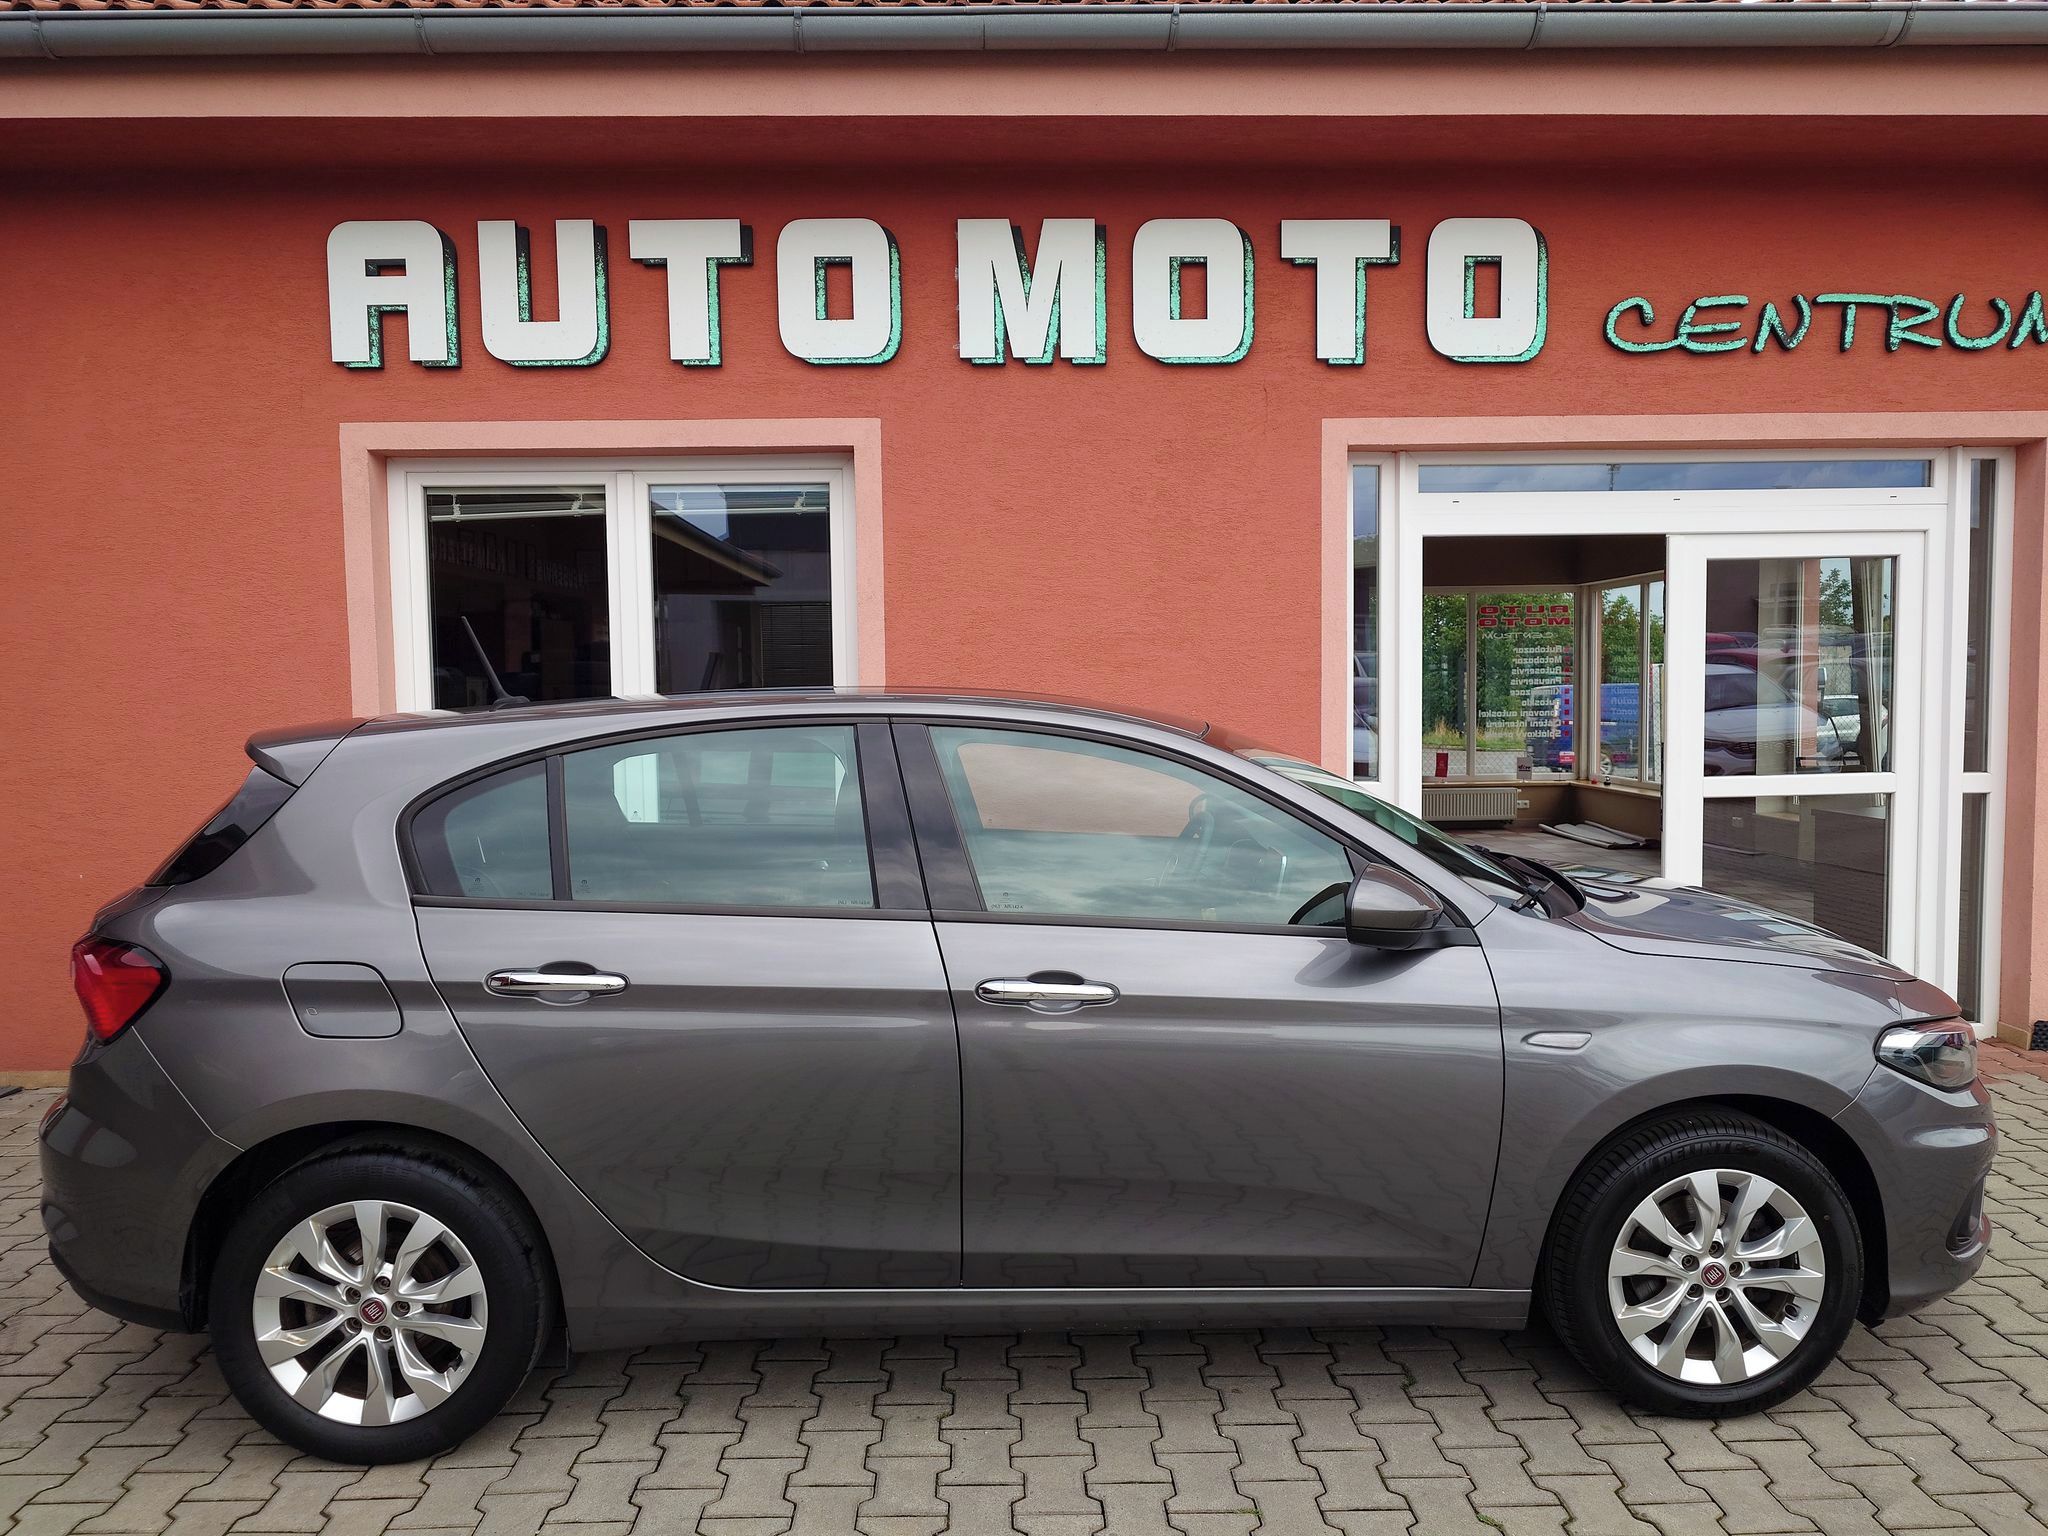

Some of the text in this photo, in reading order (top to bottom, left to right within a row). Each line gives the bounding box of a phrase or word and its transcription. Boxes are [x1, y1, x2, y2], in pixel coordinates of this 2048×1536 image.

[326, 217, 1548, 369] AUTO MOTO
[1705, 1266, 1722, 1284] FIAT
[365, 1303, 383, 1320] FIAT
